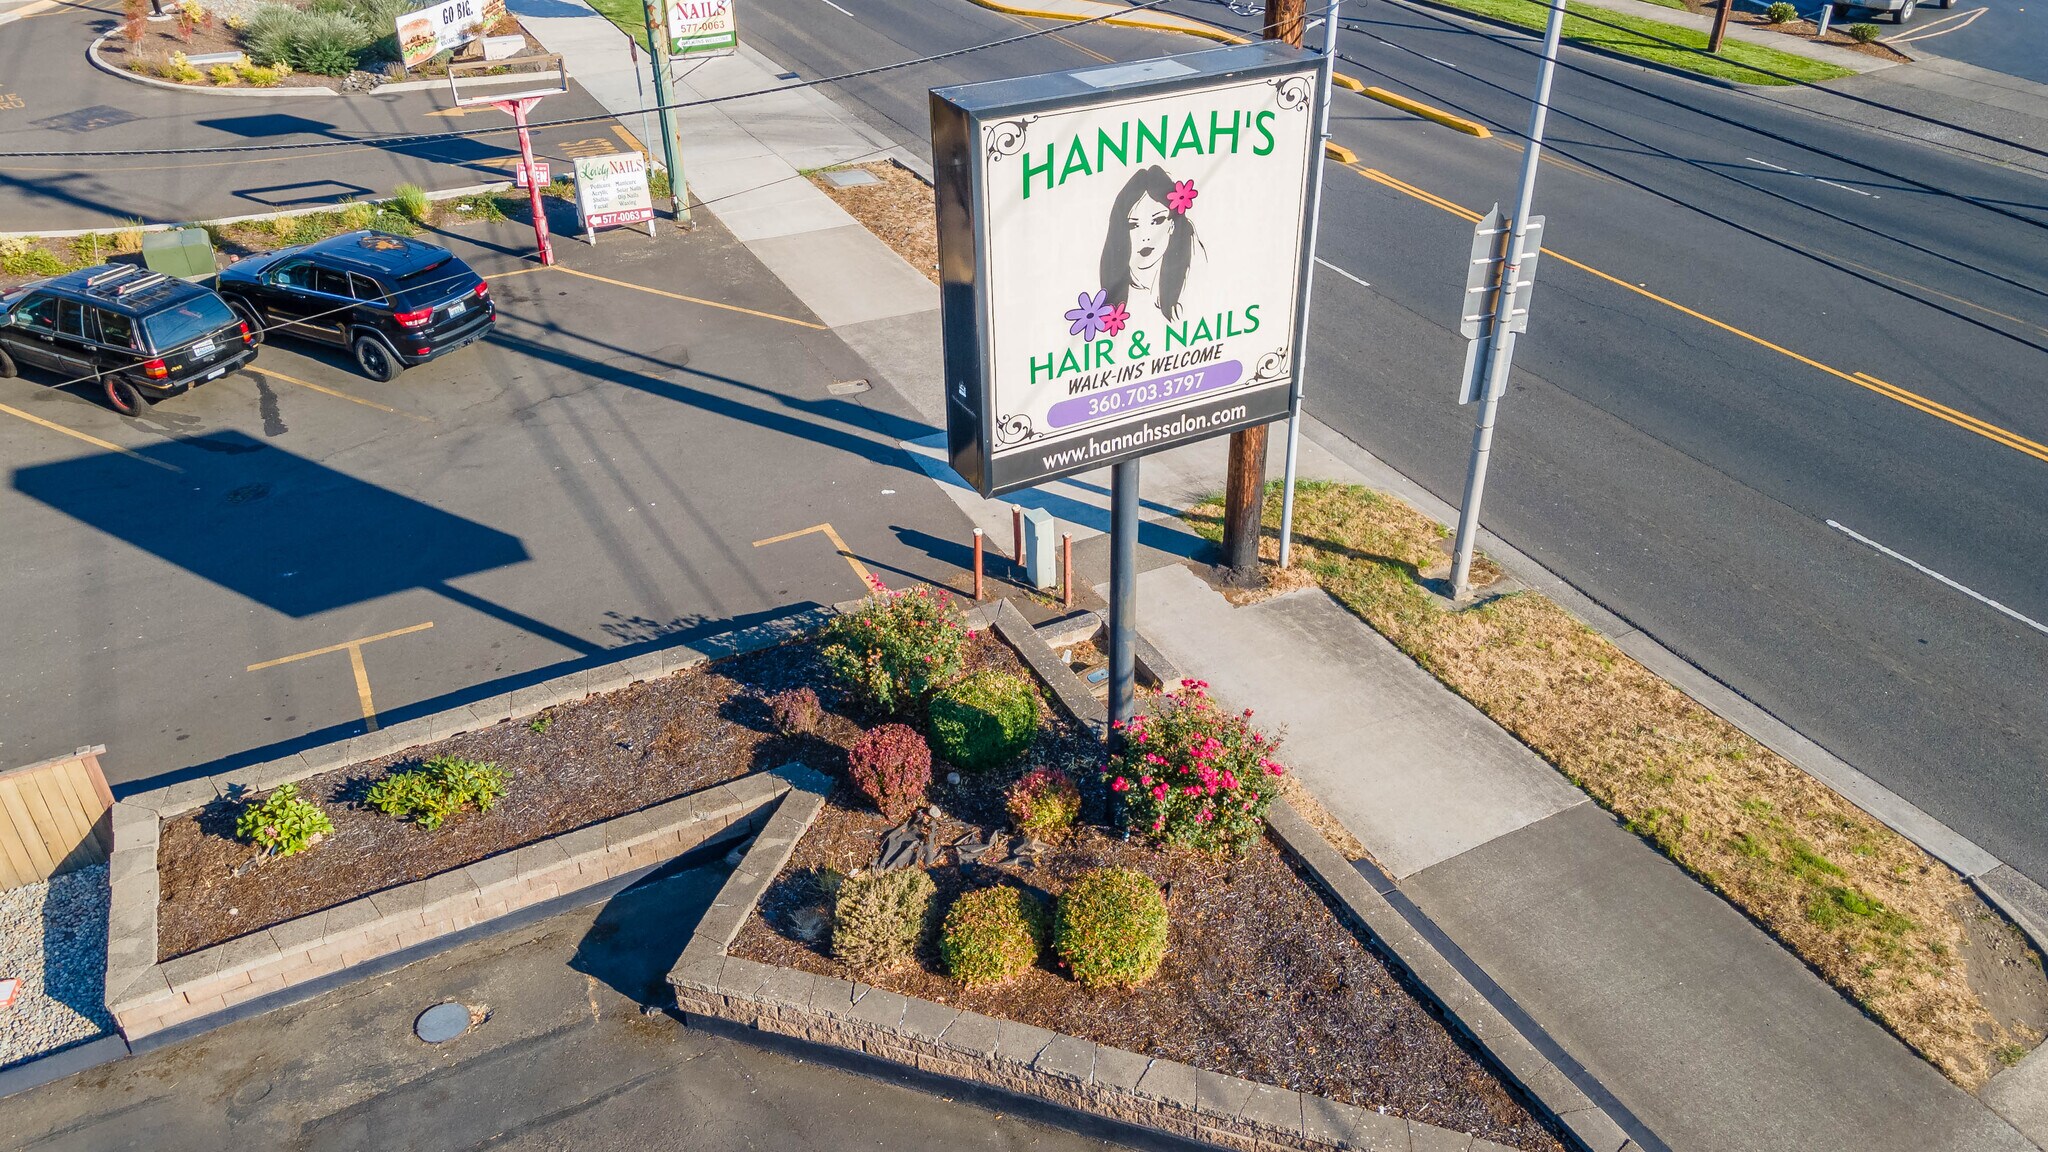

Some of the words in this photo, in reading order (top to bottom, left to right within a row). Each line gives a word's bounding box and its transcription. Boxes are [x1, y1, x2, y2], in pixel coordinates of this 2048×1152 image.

[442, 6, 454, 25] GO
[456, 0, 474, 20] BIG.
[676, 1, 726, 20] NAILS
[681, 21, 725, 33] 577-0063
[1022, 109, 1276, 200] HANNAH'S
[520, 171, 547, 183] OEN
[580, 162, 609, 181] Lovely
[609, 159, 644, 175] NAILS
[602, 211, 640, 224] 577-0063
[1030, 339, 1114, 384] HAIR
[1128, 330, 1151, 360] &
[1165, 304, 1260, 352] NAILS
[1068, 361, 1145, 396] WALK-INS
[1150, 343, 1225, 375] WELCOME
[1088, 372, 1206, 416] 360.703.3797
[1042, 403, 1247, 471] www.hannahssalon.com
